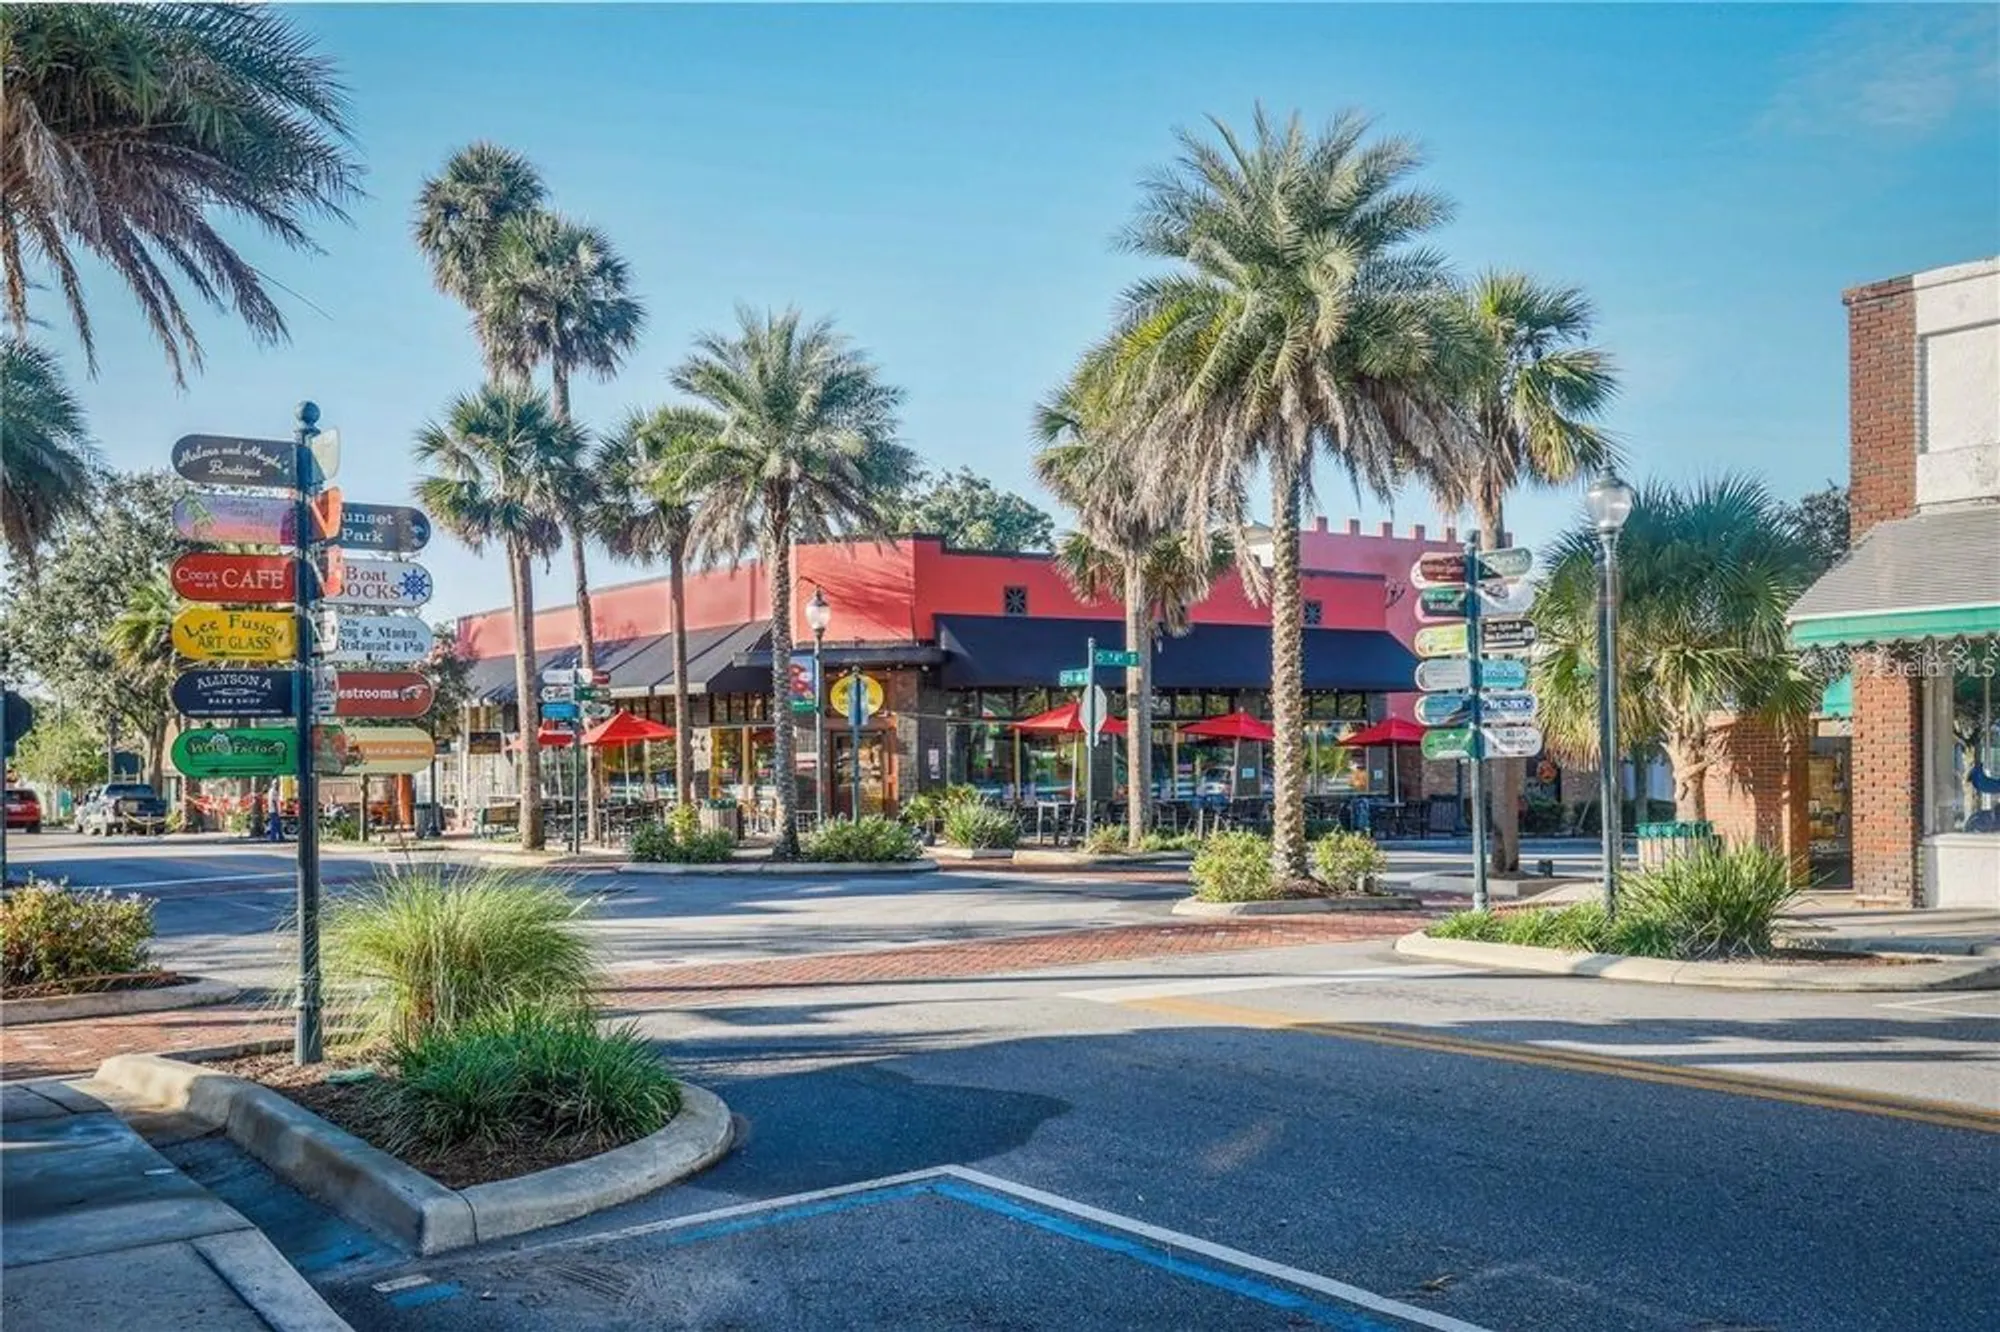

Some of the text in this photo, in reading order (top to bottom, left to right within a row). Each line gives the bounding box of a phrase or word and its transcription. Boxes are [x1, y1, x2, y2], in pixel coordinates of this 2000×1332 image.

[208, 459, 261, 479] Boutique
[341, 512, 394, 525] unset
[341, 528, 383, 543] Park
[222, 567, 285, 590] CAFE
[346, 566, 388, 581] Boat
[184, 614, 284, 640] Lee Fusion
[197, 635, 271, 650] ART GLASS
[197, 674, 260, 690] ALLYSON
[340, 687, 399, 700] estrooms
